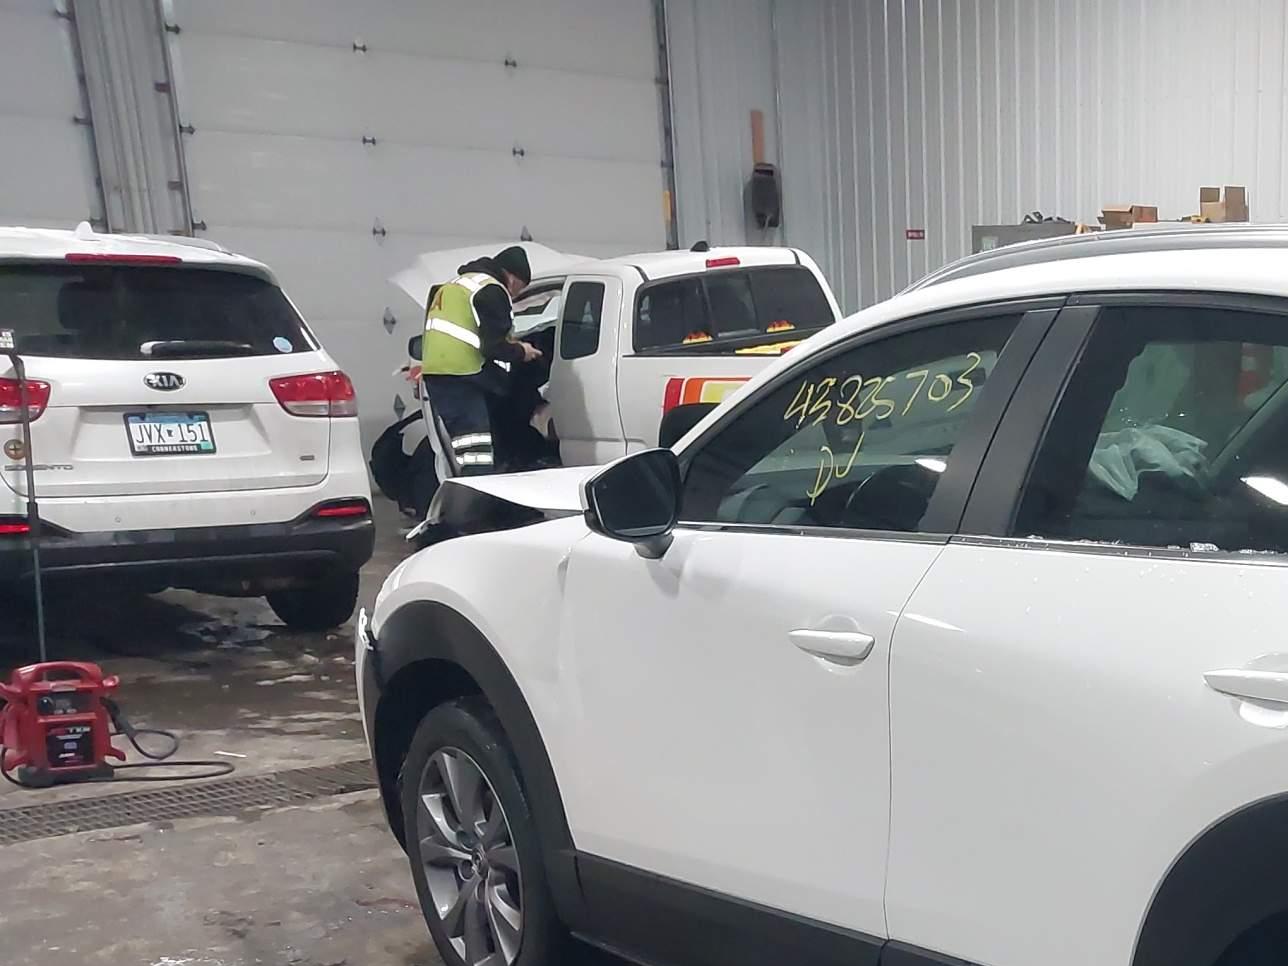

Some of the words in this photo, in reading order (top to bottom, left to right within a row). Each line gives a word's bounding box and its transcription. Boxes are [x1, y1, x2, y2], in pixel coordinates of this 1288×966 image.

[145, 373, 183, 389] KIA
[136, 424, 166, 443] JVX
[178, 423, 209, 442] 151
